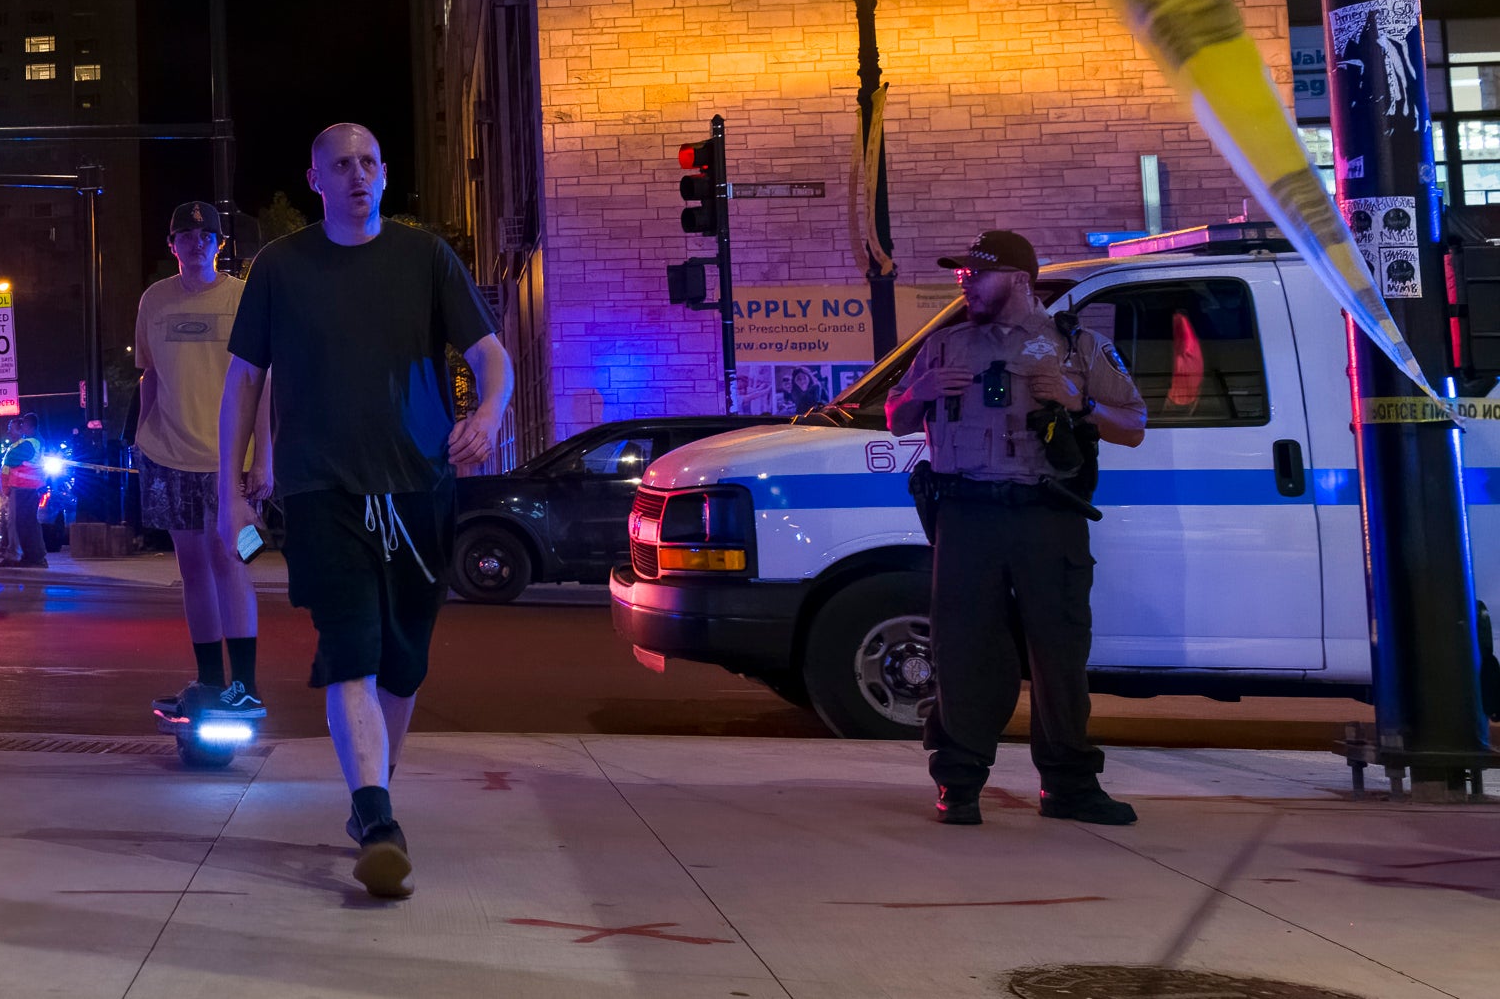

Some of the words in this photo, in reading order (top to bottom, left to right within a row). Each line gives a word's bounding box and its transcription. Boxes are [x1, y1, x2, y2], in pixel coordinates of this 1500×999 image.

[732, 298, 812, 319] APPLY
[822, 298, 873, 318] NO
[857, 322, 866, 333] 8
